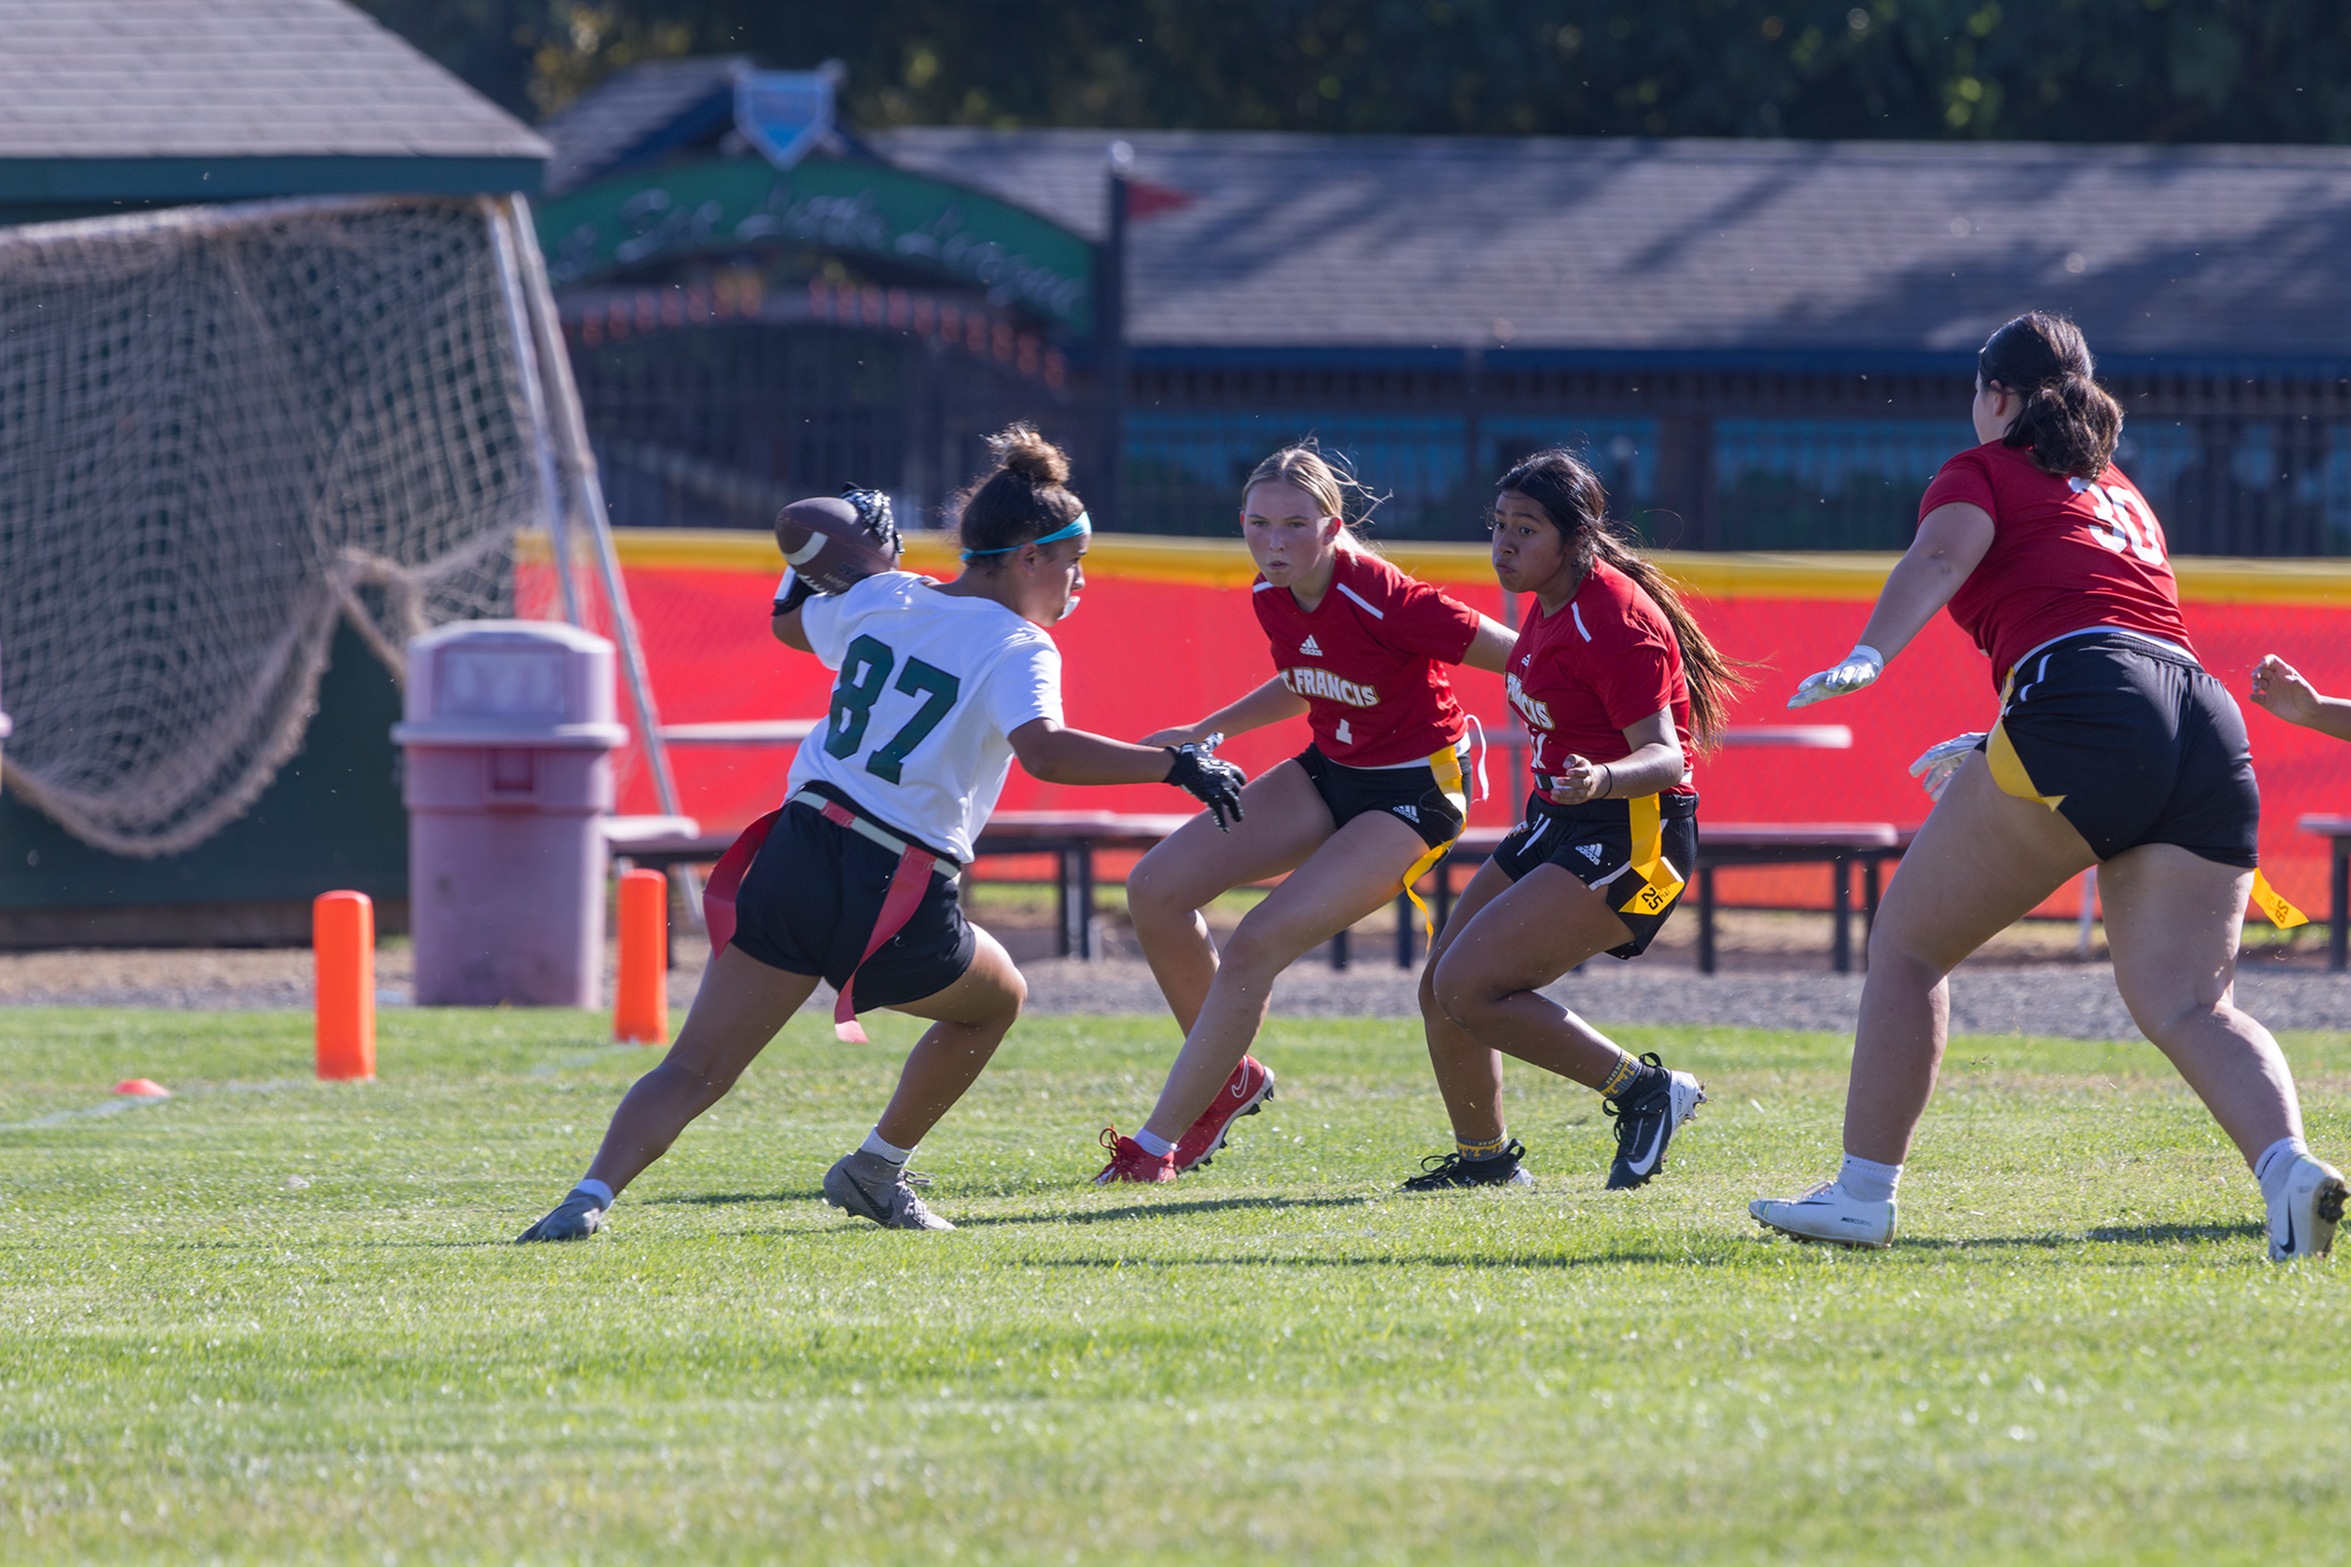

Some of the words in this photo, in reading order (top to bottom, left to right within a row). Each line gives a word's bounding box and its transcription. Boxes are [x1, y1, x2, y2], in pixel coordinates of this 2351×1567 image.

[2067, 476, 2164, 566] 30
[1292, 668, 1379, 707] FRANCIS
[824, 633, 960, 785] 87
[1335, 718, 1352, 745] 1
[1575, 845, 1600, 866] adidas
[1641, 886, 1663, 910] 25
